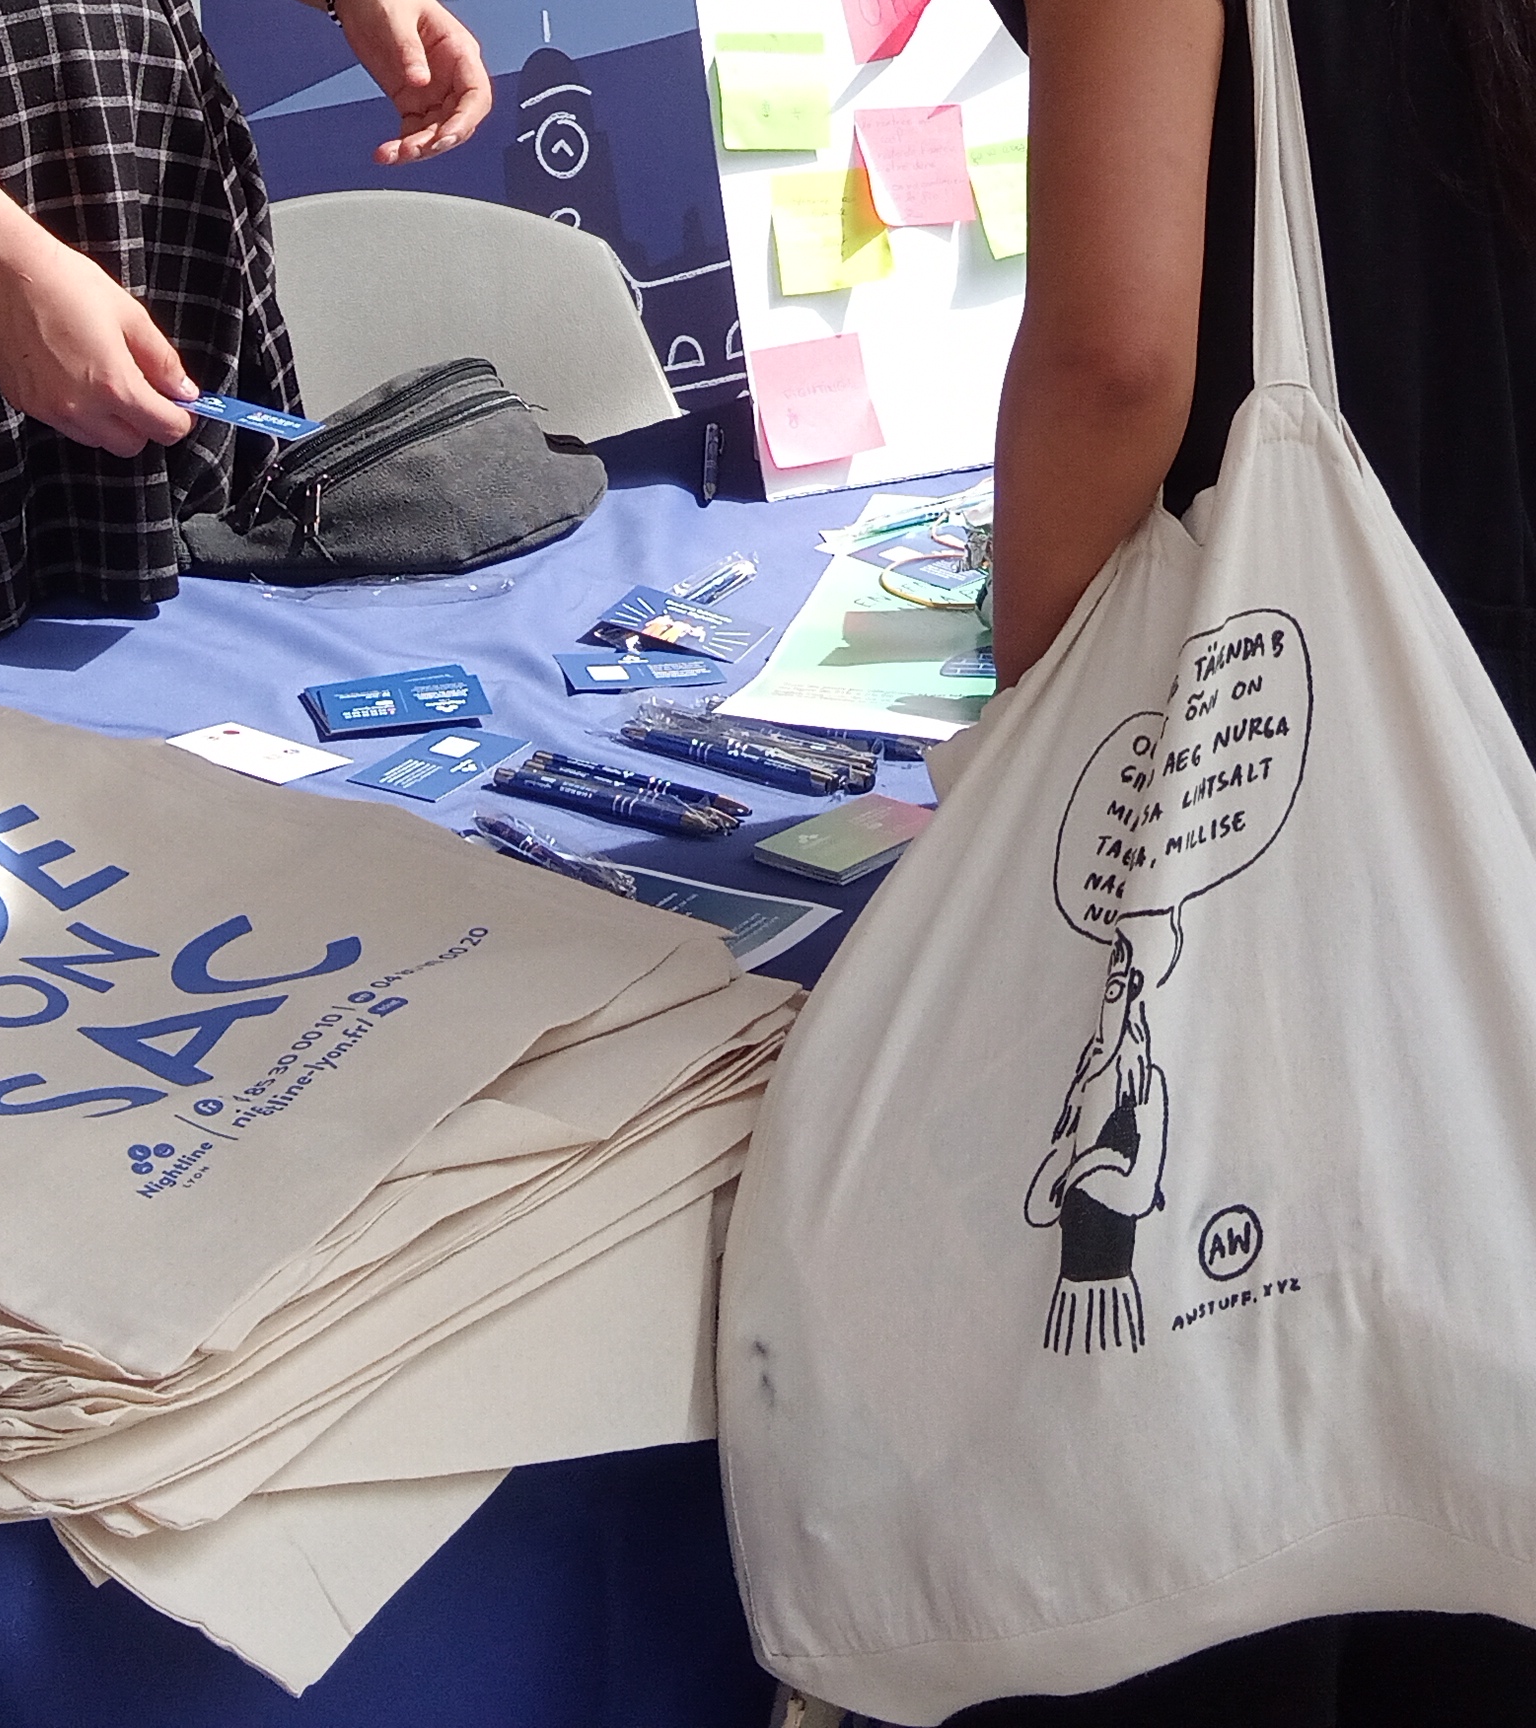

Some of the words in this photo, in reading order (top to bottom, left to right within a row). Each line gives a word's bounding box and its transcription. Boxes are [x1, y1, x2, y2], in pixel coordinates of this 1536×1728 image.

[1230, 674, 1263, 701] ON
[268, 1054, 298, 1079] 30
[291, 1030, 323, 1052] 00
[313, 1012, 344, 1029] 10
[459, 926, 489, 947] 20
[135, 1140, 214, 1200] Nightline
[181, 1165, 211, 1189] LYON
[1207, 1220, 1253, 1266] AW
